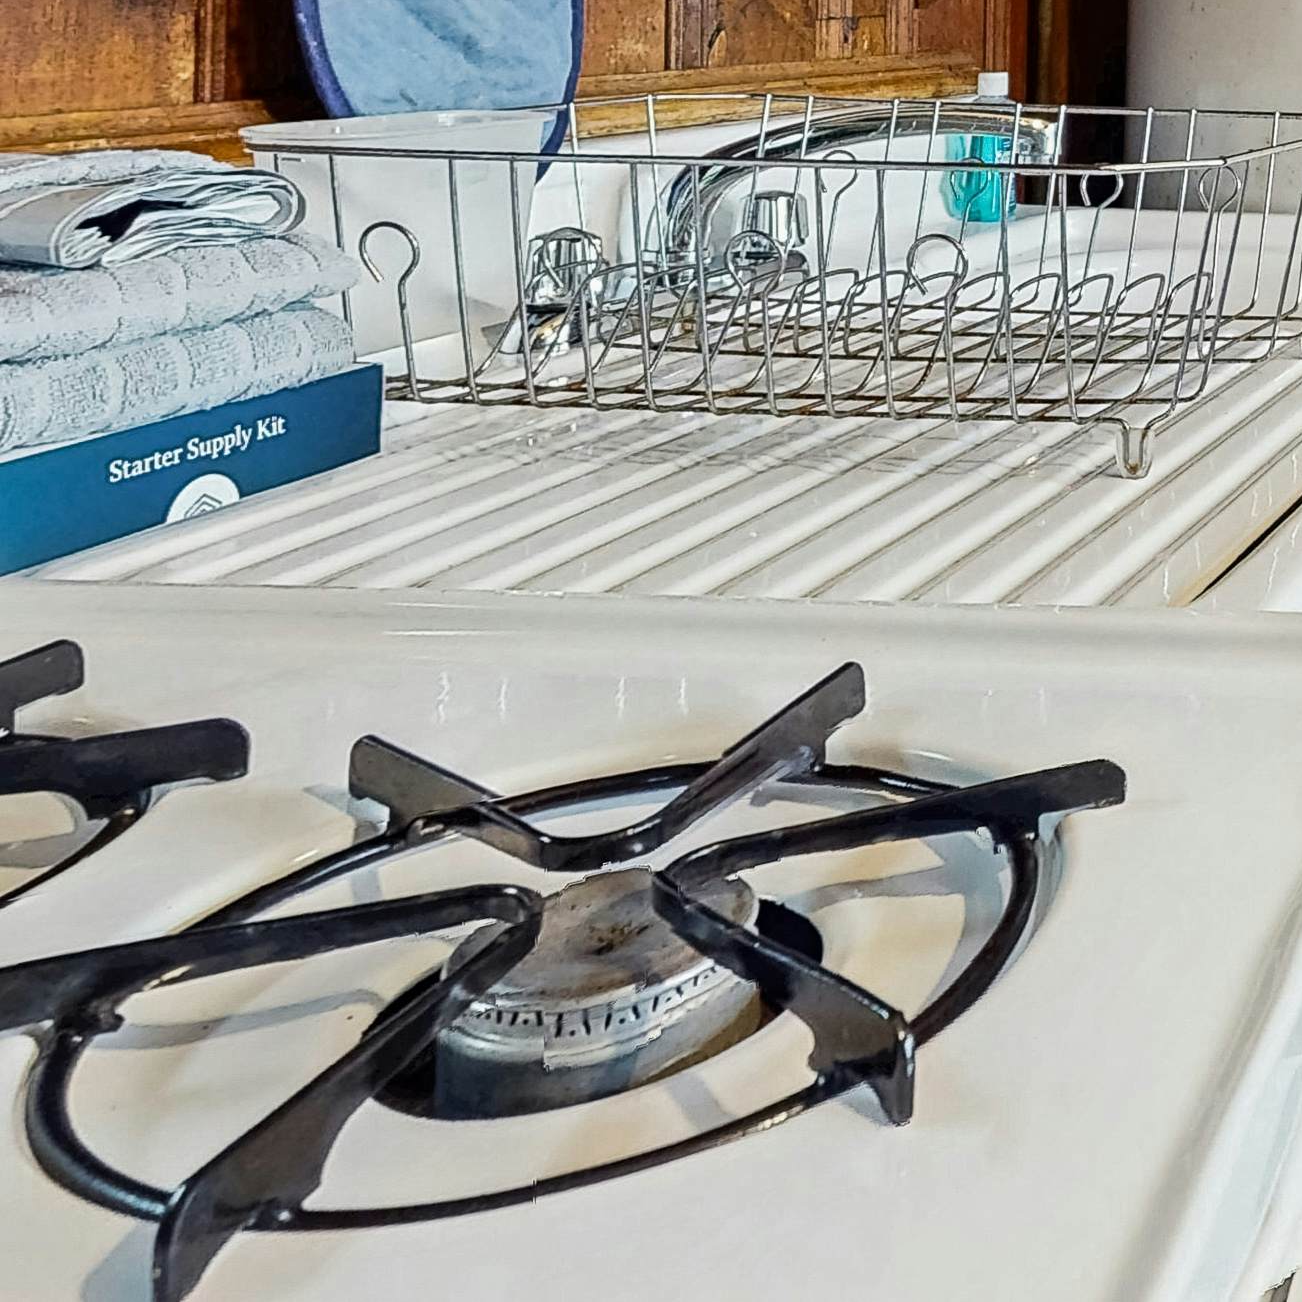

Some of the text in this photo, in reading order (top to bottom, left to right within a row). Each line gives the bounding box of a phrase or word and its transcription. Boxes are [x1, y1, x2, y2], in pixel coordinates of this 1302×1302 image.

[109, 416, 287, 483] Starter Supply Kit
